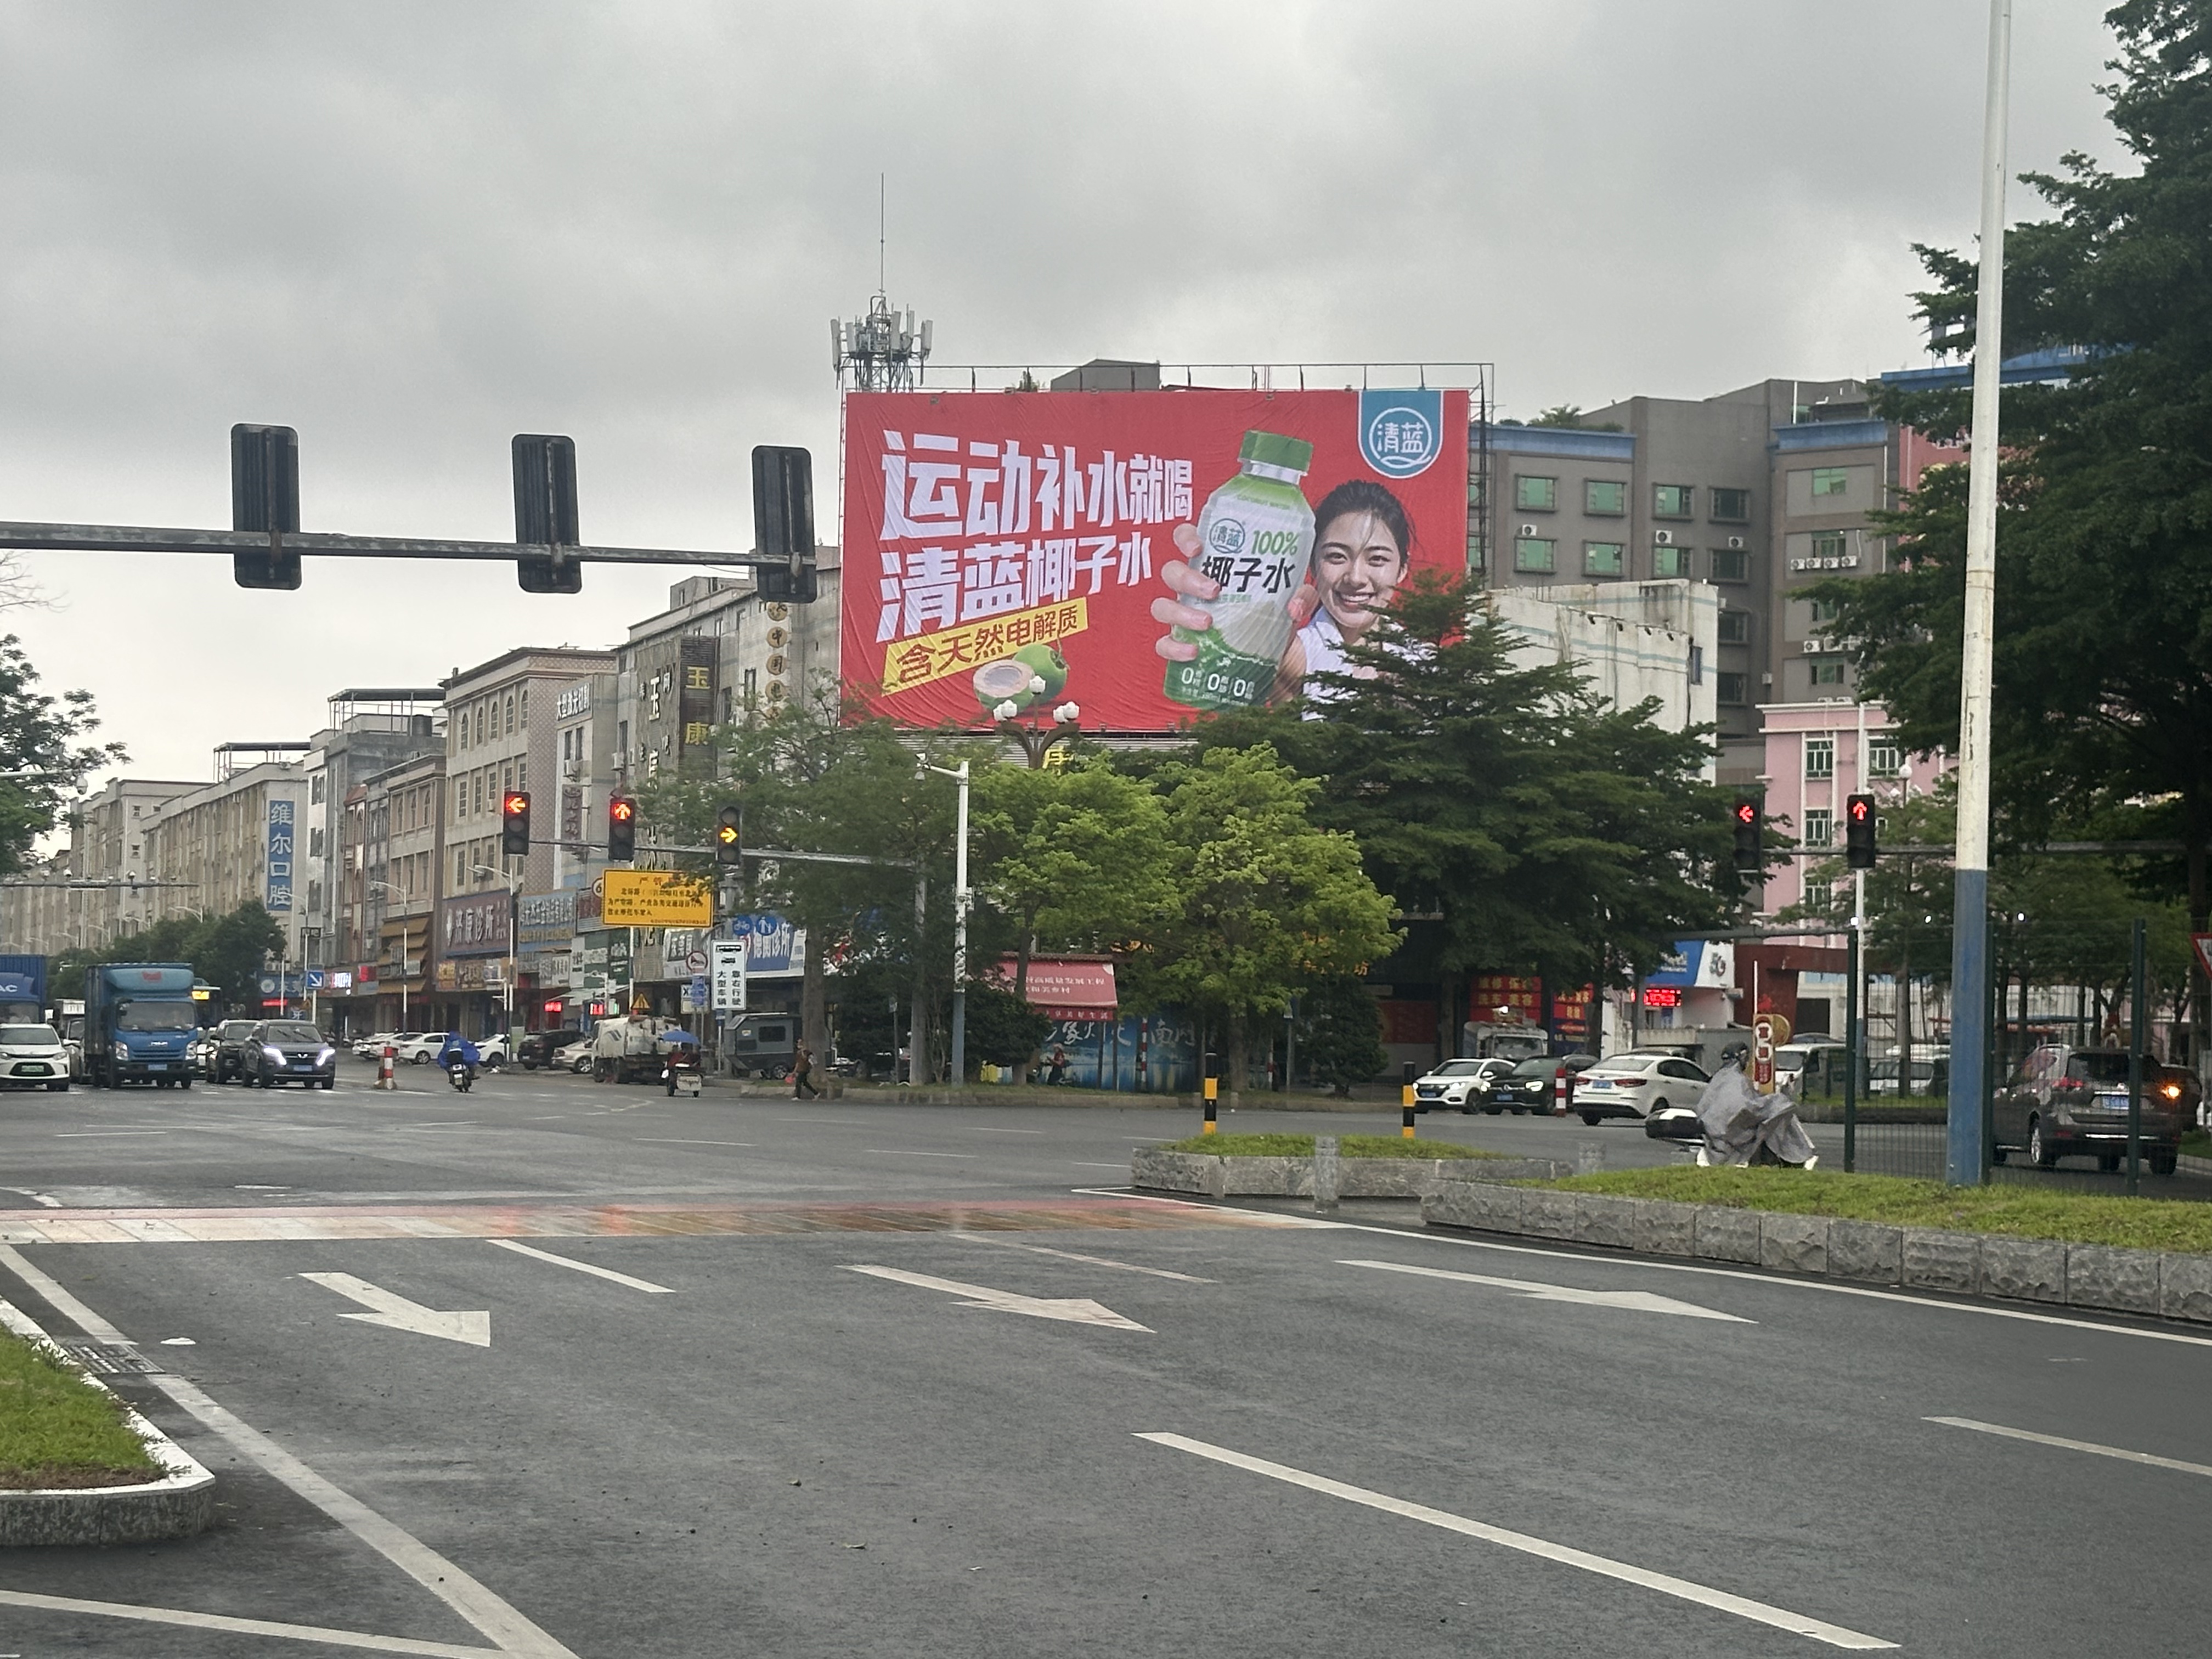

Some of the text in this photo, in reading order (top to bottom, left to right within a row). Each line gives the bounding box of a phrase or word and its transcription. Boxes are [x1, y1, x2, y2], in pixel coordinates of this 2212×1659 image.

[1377, 421, 1424, 453] 清蓝
[879, 430, 1193, 540] 运动补水就喝
[1201, 556, 1296, 594] 椰子水
[1251, 529, 1300, 556] 100%
[876, 532, 1152, 643] 清蓝椰子水
[896, 604, 1078, 683] 含天然电解质
[685, 666, 710, 746] 玉康
[268, 803, 292, 906] 维尔口腔
